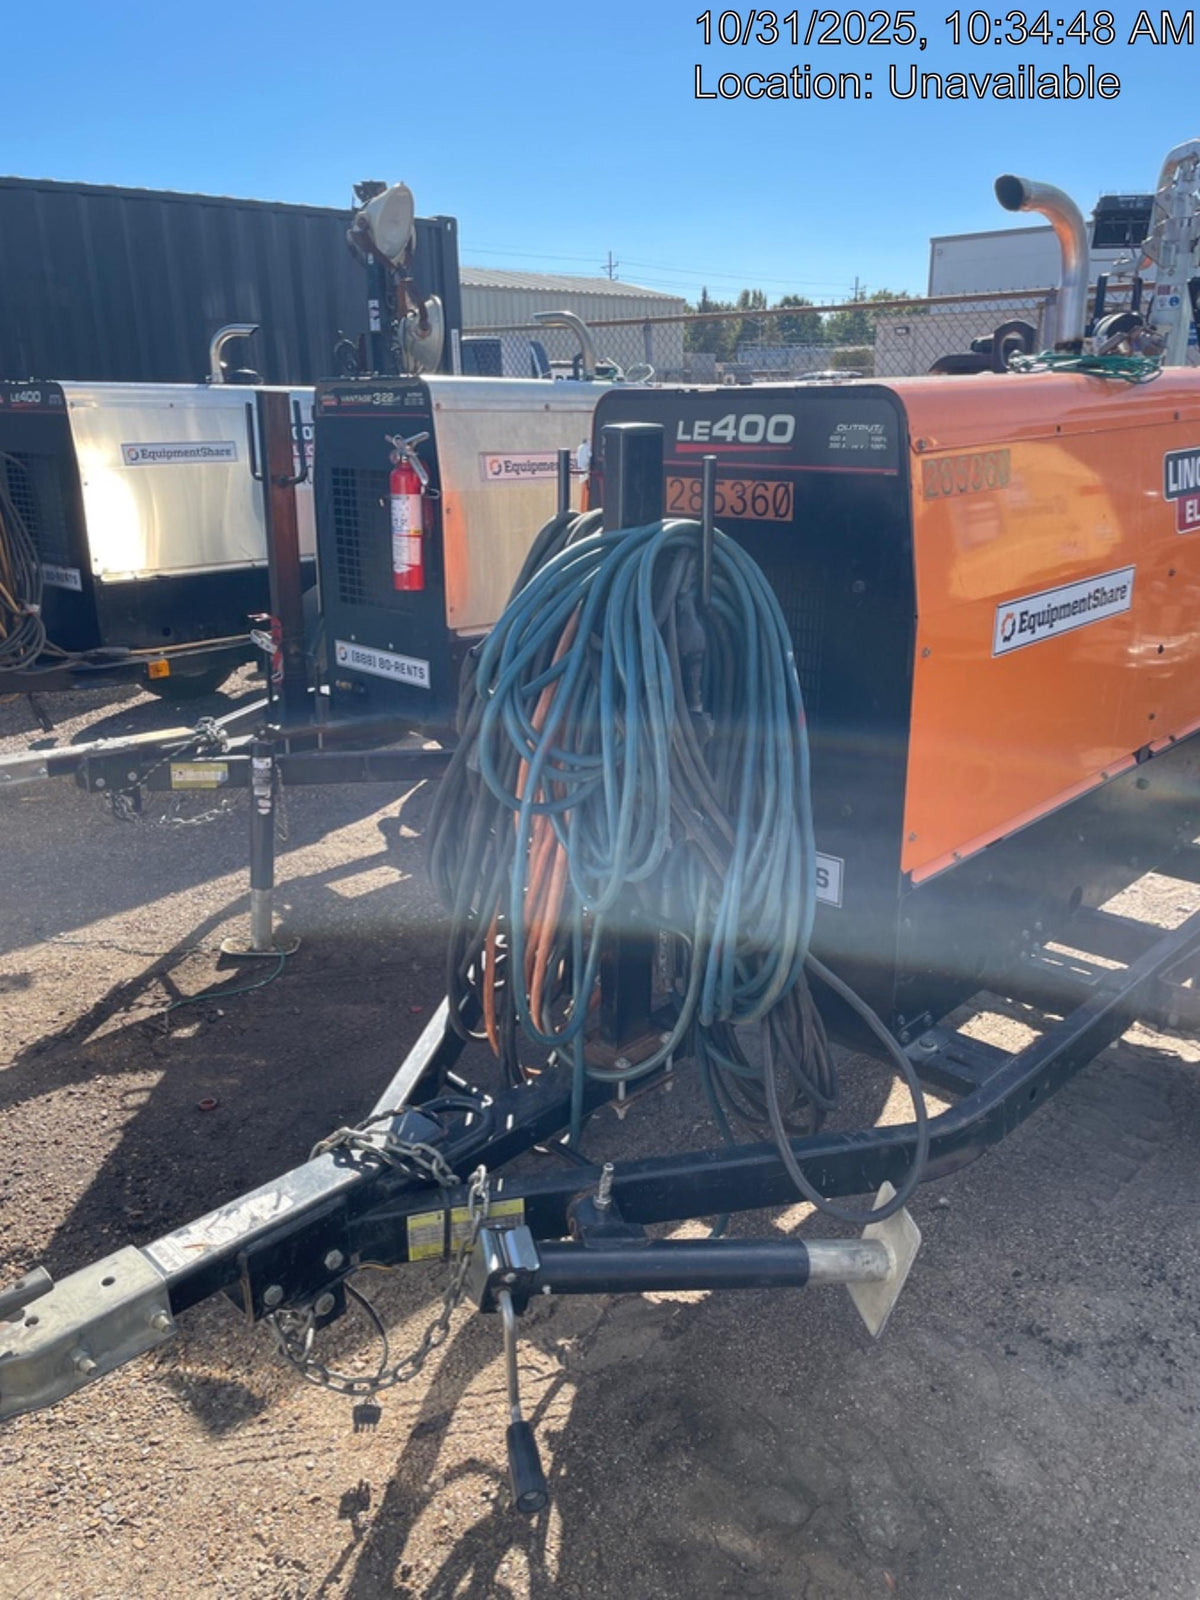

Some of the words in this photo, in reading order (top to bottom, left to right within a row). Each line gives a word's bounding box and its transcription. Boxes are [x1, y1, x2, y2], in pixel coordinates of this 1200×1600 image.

[676, 414, 795, 444] LE400
[140, 446, 232, 460] EquipmentShare
[1018, 583, 1128, 634] EquipmentShare
[378, 657, 425, 680] 80-RENTS
